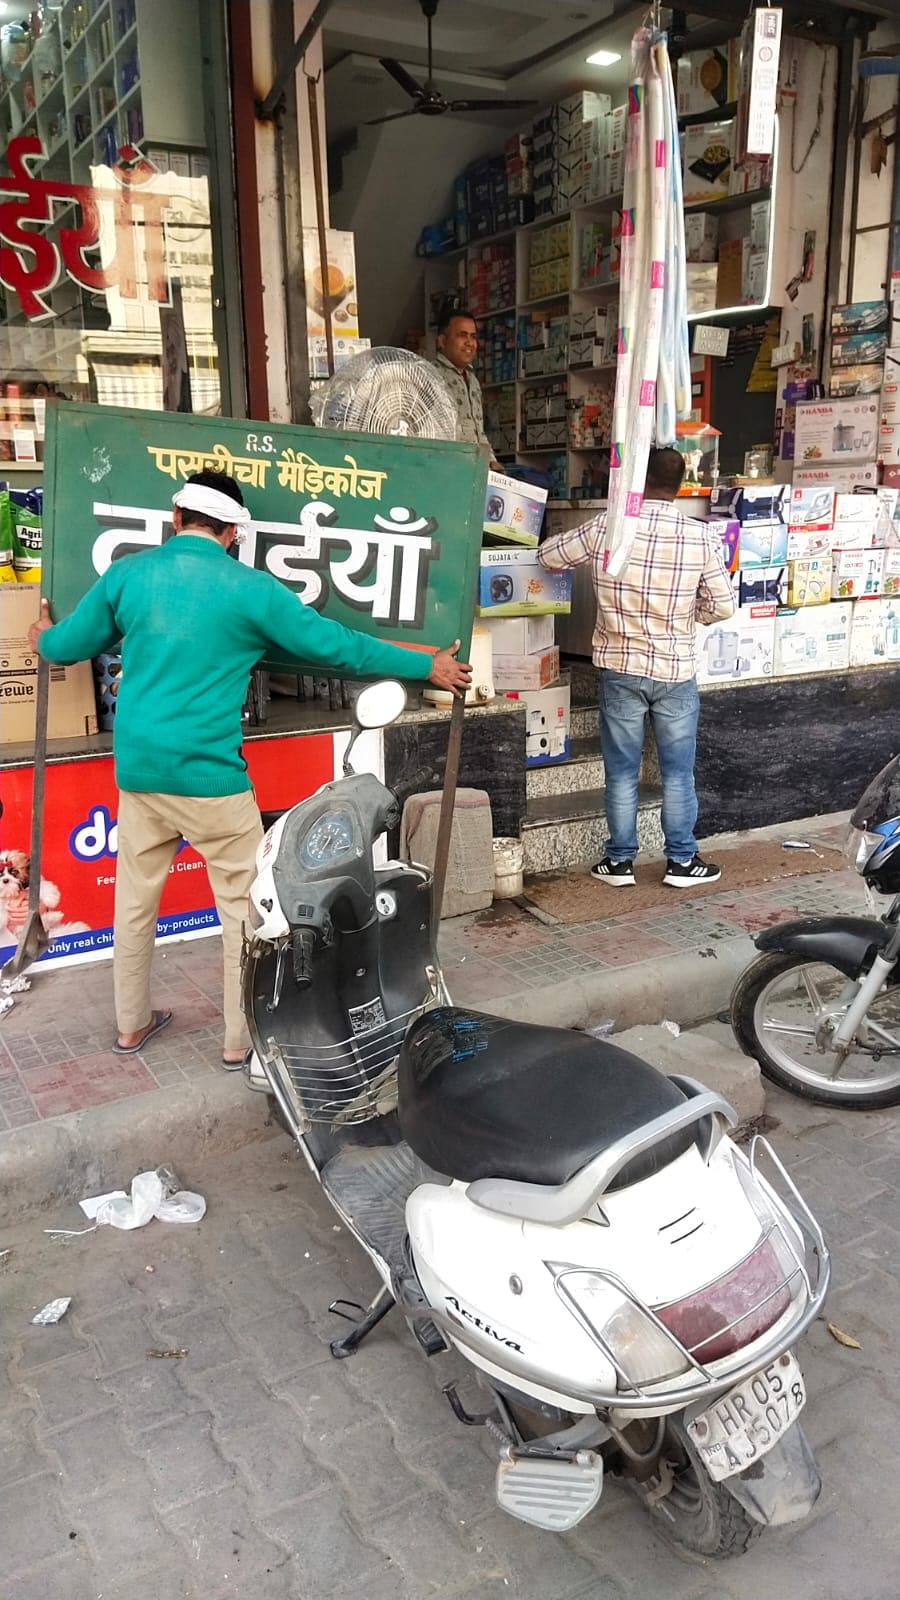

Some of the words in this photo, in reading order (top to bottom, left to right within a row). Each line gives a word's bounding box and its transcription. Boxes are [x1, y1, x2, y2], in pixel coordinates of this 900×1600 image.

[488, 554, 511, 562] SUJATA
[177, 861, 207, 872] Clean.
[47, 941, 71, 954] Only
[74, 936, 95, 949] real
[157, 914, 215, 933] by-products
[444, 1296, 525, 1355] Activa
[716, 1395, 753, 1436] HR
[751, 1364, 783, 1405] 05
[706, 1442, 722, 1457] IND
